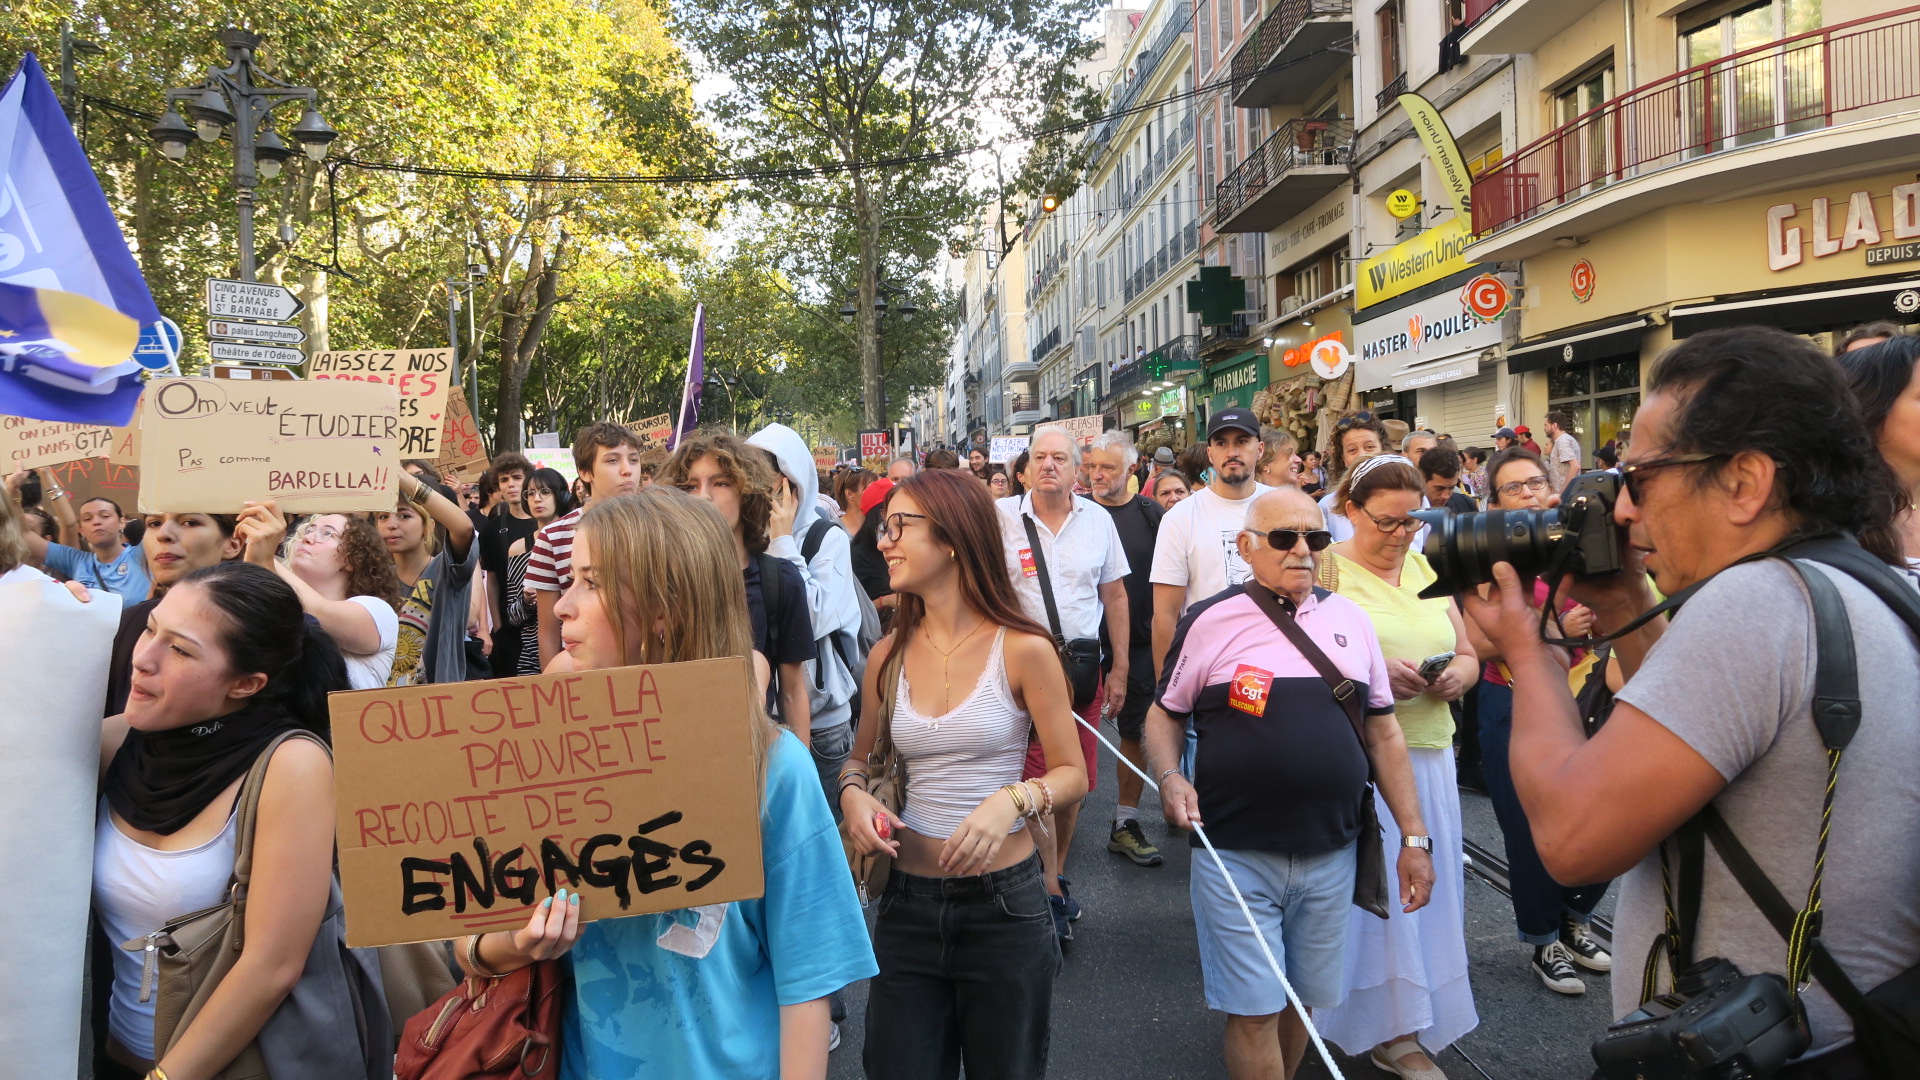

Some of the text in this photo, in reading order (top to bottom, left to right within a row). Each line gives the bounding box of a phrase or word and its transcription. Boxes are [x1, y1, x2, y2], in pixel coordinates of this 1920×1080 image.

[1302, 217, 1316, 240] CAFÉ
[1317, 201, 1345, 231] FROMAGE
[1388, 249, 1434, 284] Western
[1435, 233, 1474, 264] Union
[1867, 245, 1914, 263] DEPUIS
[1574, 268, 1587, 290] G
[214, 283, 281, 298] CINQ AVENUES
[214, 293, 268, 307] LE CAMAS
[1474, 284, 1498, 310] G
[1900, 294, 1914, 307] G
[230, 304, 279, 318] BARNABÉ
[231, 327, 298, 341] palais Longchamp
[217, 347, 297, 360] théâtre de l'Odéon
[1362, 332, 1408, 361] MASTER
[407, 352, 448, 372] NOS
[1213, 364, 1257, 395] PHARMACIE
[279, 406, 398, 439] ÉTUDIER
[1077, 416, 1103, 430] PASTIS
[38, 440, 70, 456] DANS
[75, 428, 113, 450] GTA
[219, 455, 271, 465] comme
[1179, 654, 1189, 671] PARK
[1241, 686, 1264, 701] cgt
[359, 694, 459, 744] QUI
[606, 669, 663, 717] LA
[1230, 698, 1255, 713] TELECOMS
[460, 717, 667, 788] PAUVRETE
[354, 787, 613, 848] RECOLTE DES
[400, 810, 726, 917] ENGAGÉS
